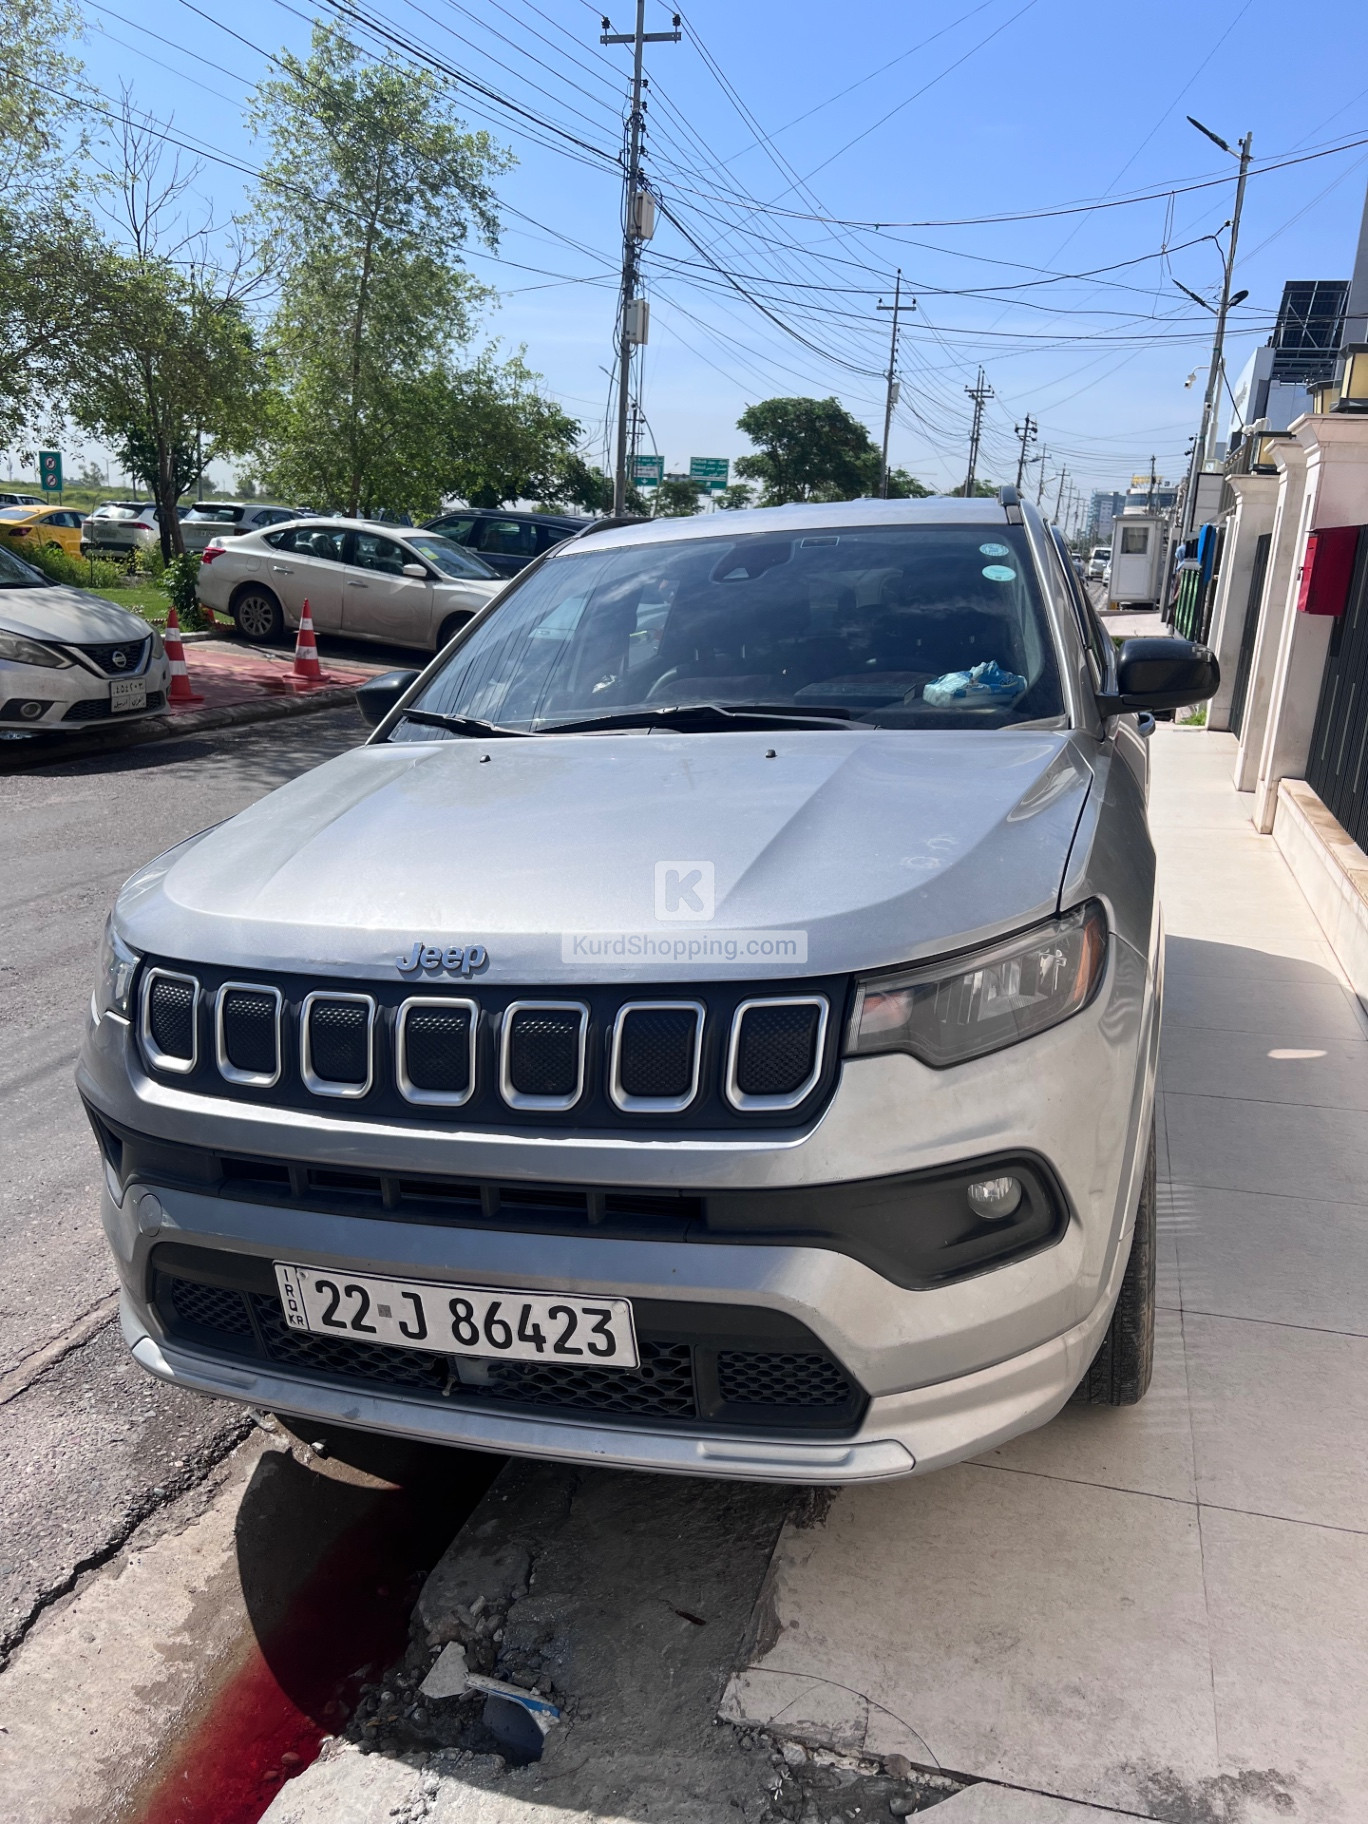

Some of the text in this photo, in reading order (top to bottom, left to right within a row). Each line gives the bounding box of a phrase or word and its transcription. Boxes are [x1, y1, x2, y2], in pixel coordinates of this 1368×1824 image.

[396, 941, 488, 975] Jeep
[288, 1314, 305, 1331] KR
[448, 1297, 617, 1358] 86423
